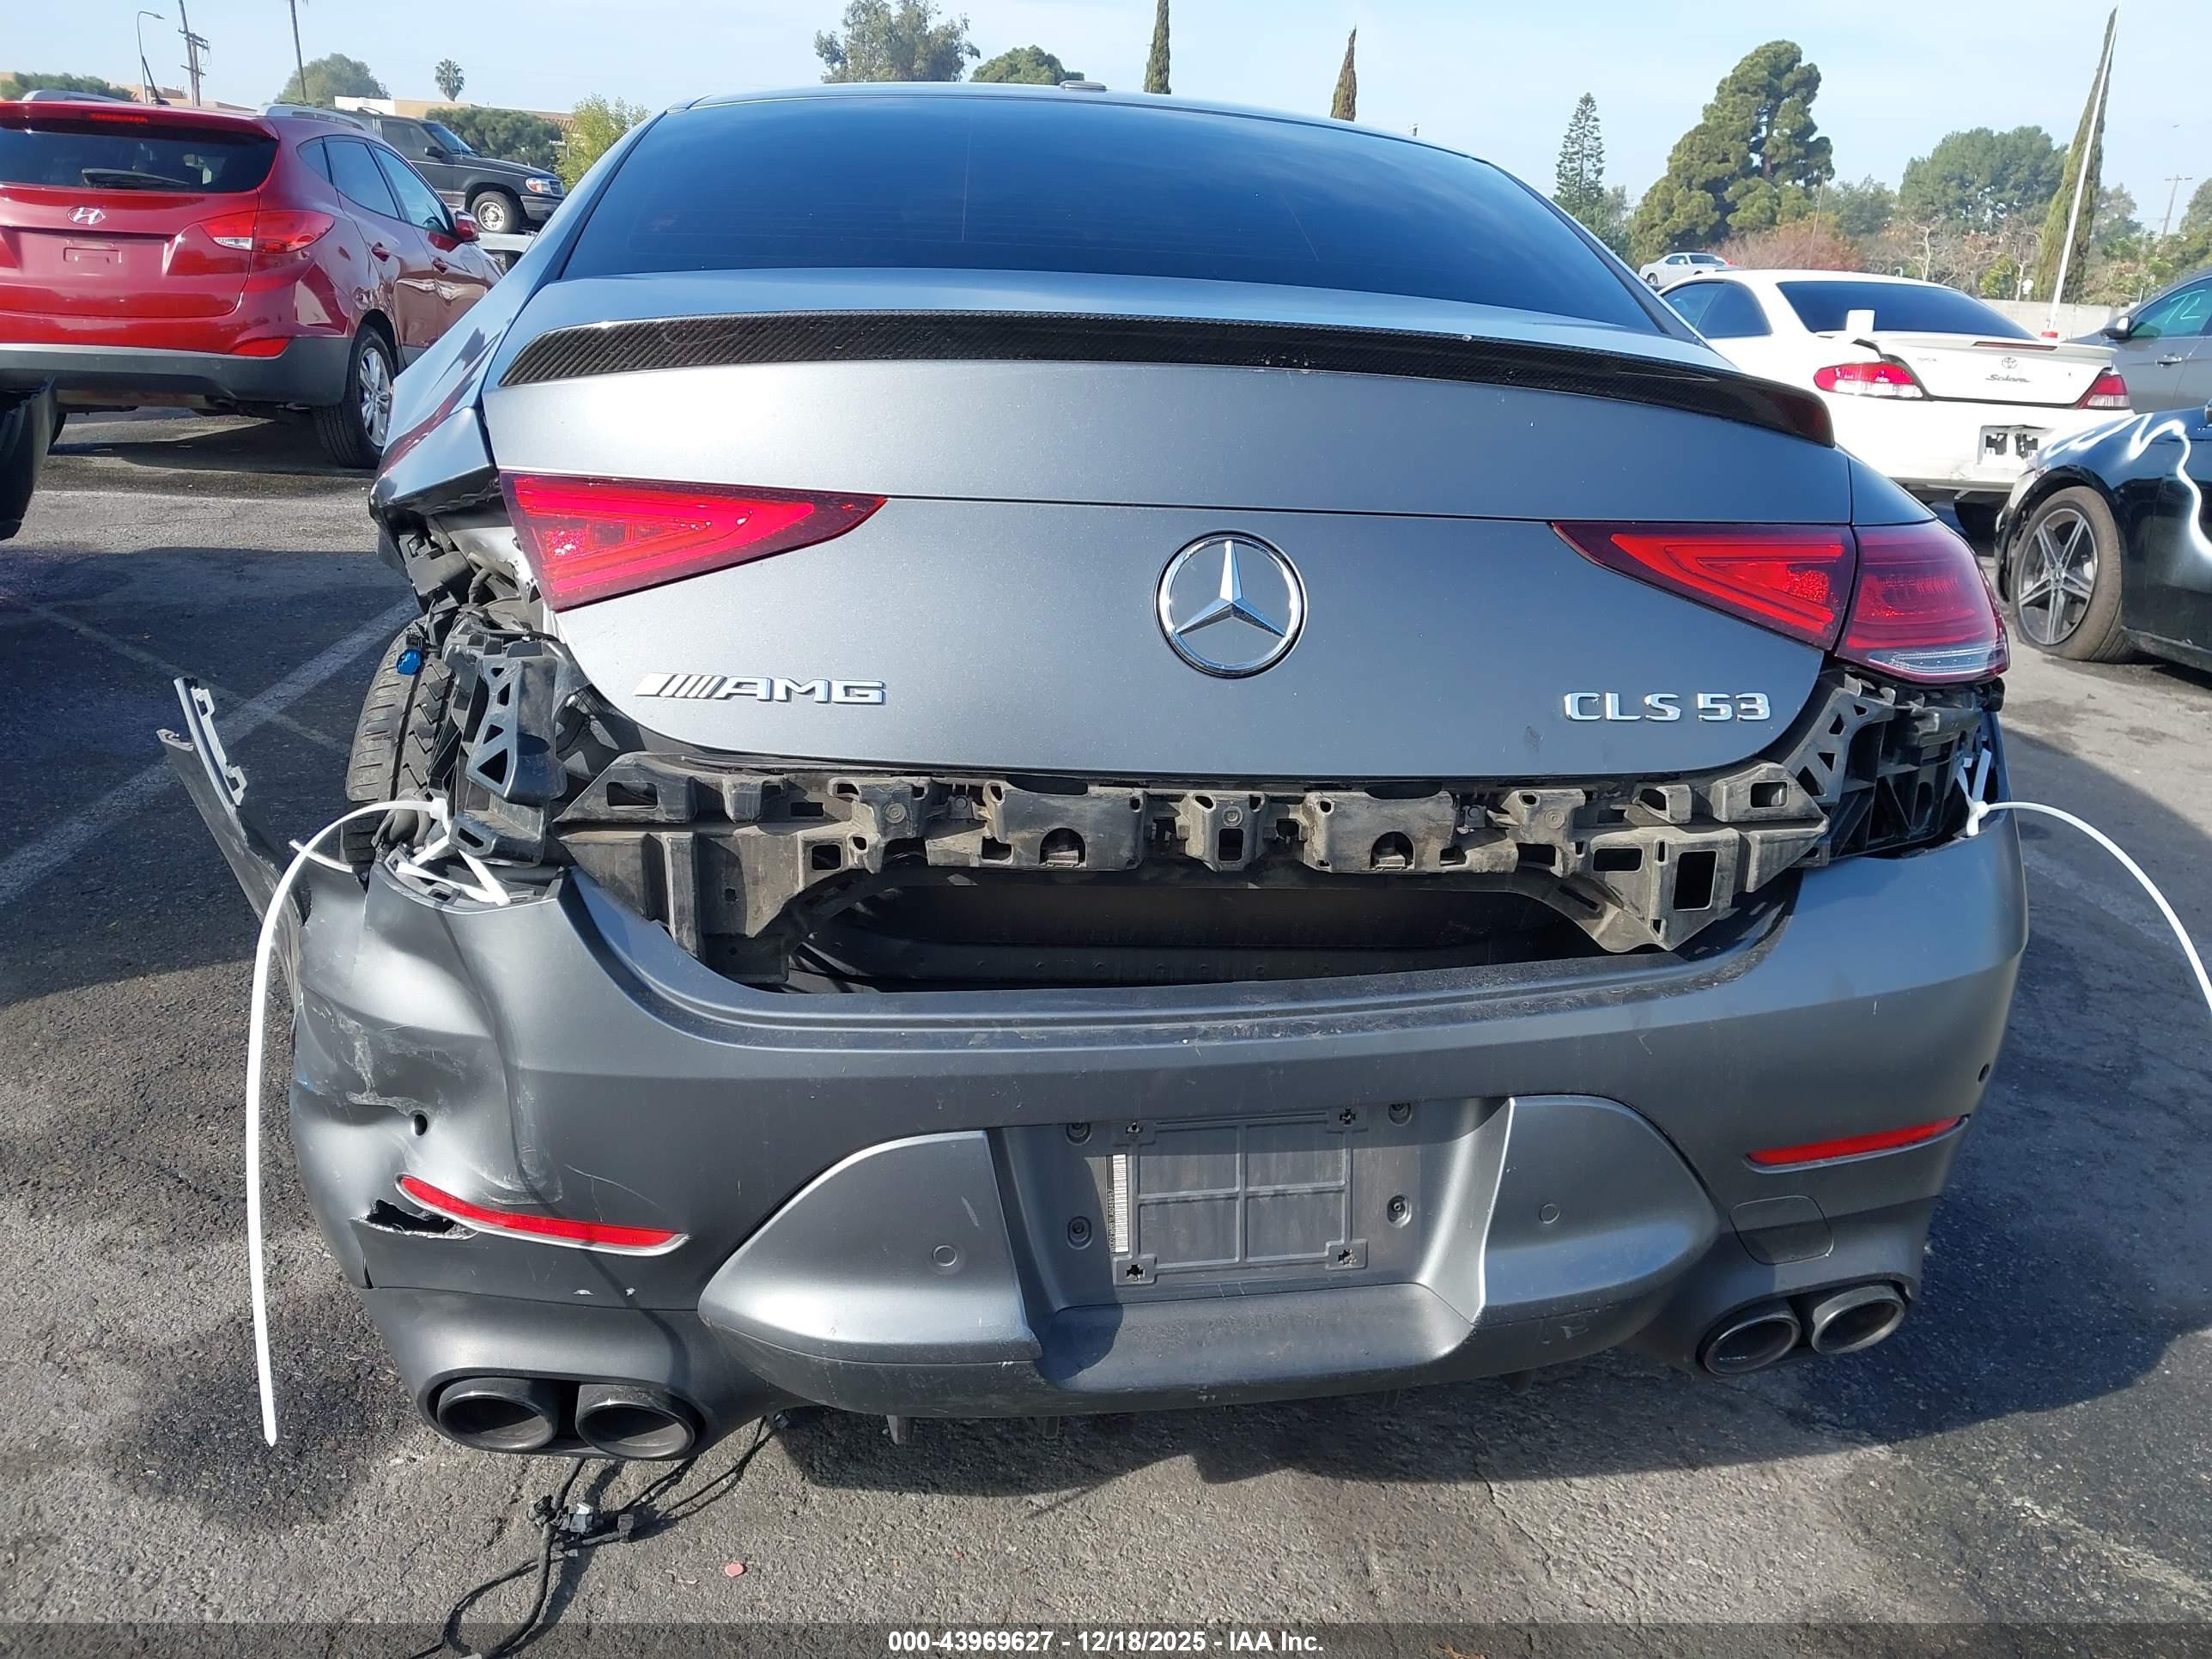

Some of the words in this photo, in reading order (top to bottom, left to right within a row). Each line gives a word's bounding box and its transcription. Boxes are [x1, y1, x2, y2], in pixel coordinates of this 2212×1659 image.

[714, 675, 886, 705] AMG
[1564, 691, 1681, 722] CLS
[1697, 691, 1771, 722] 53
